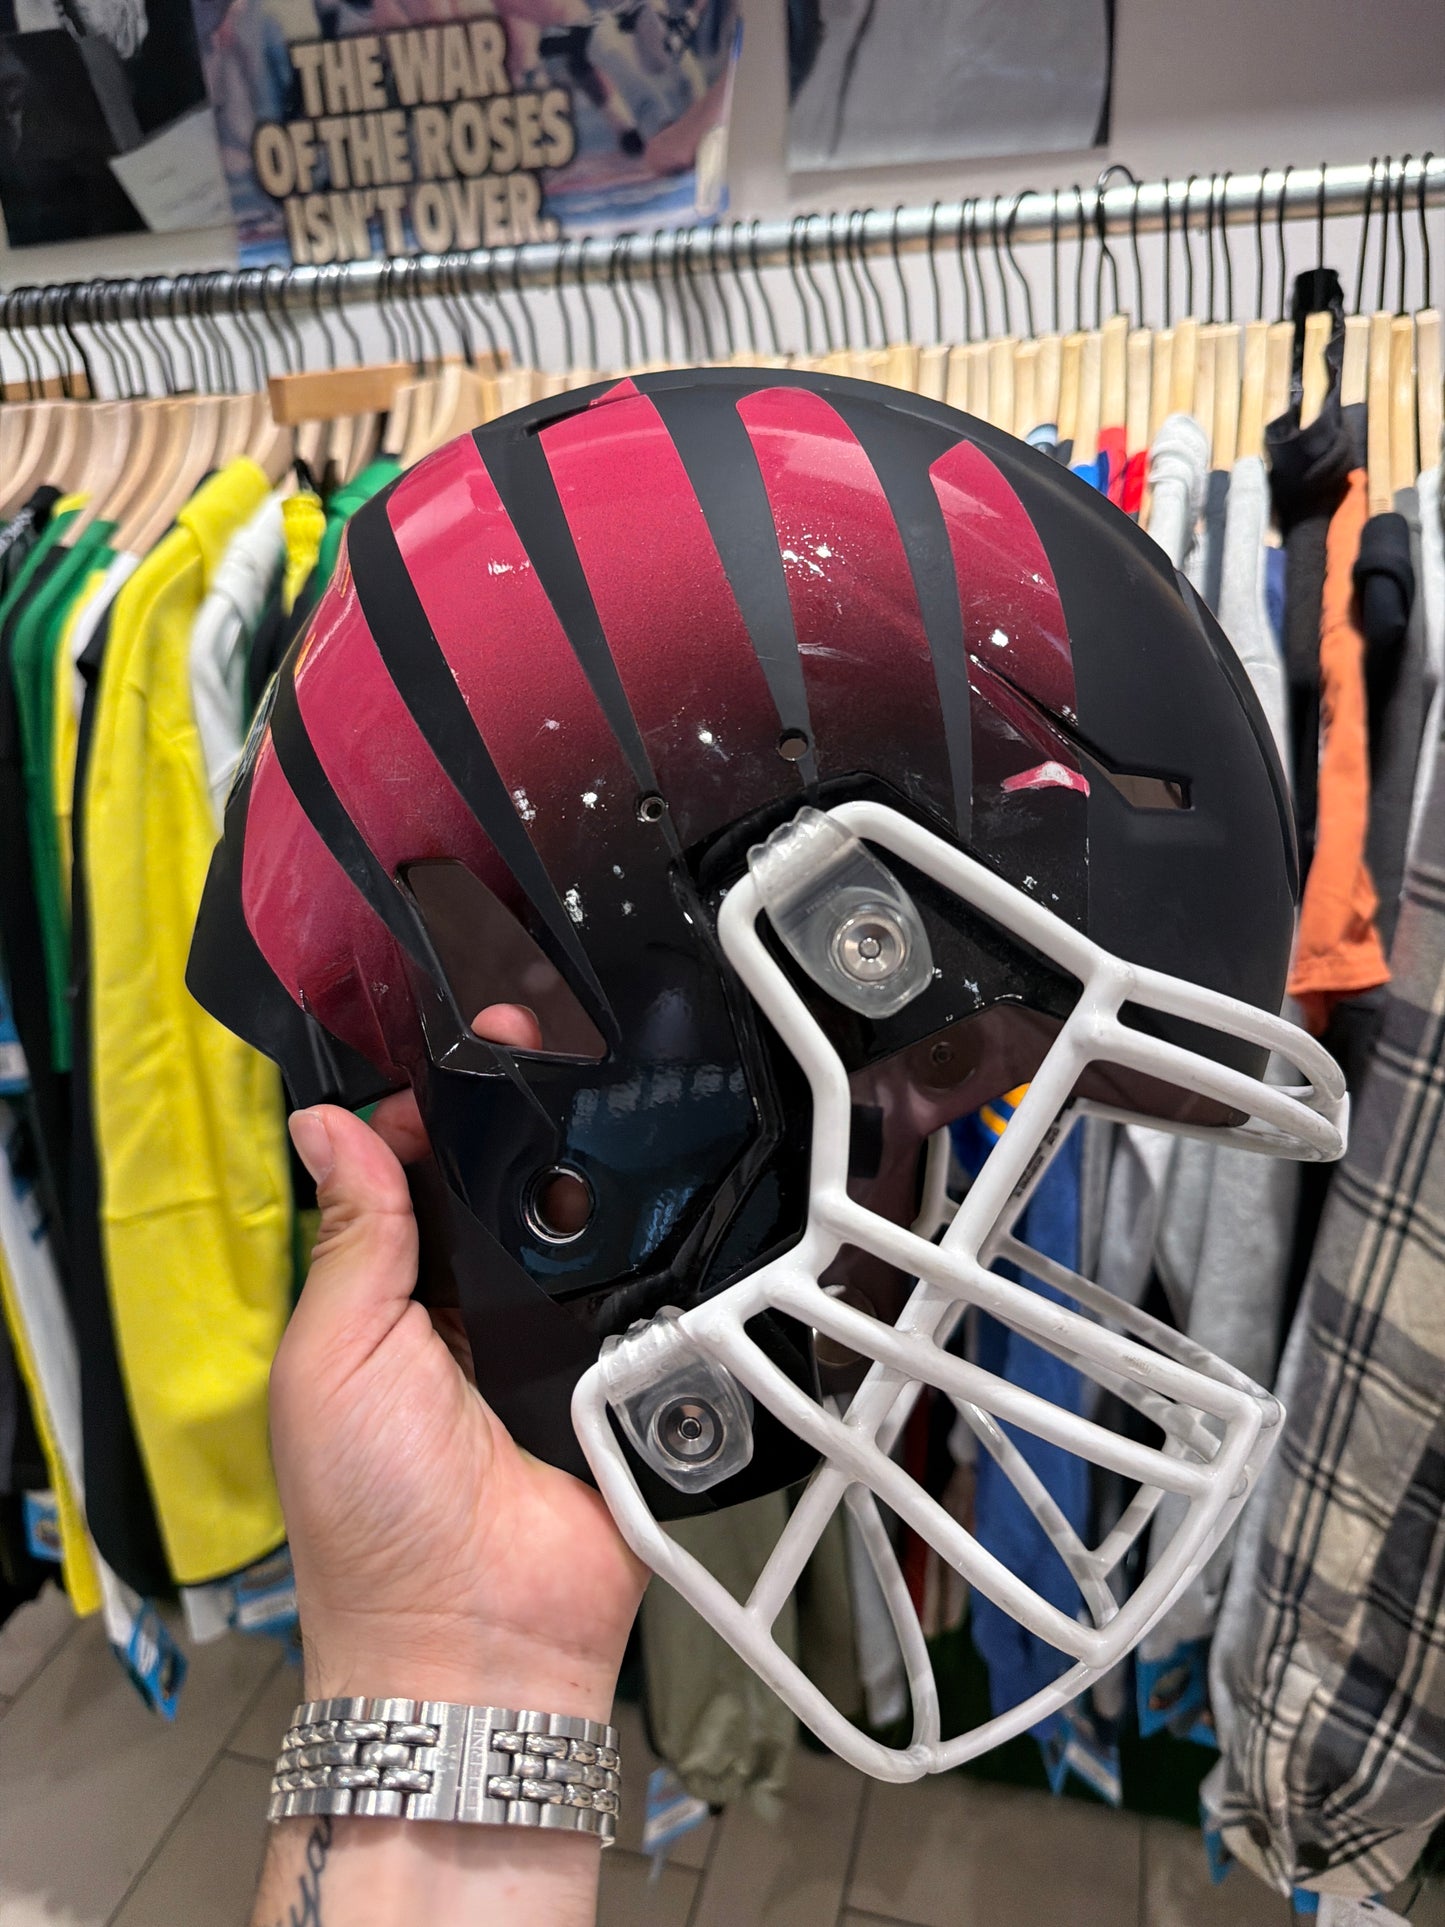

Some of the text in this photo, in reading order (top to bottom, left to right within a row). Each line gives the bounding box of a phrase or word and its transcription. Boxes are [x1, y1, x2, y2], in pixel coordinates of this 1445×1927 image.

[290, 21, 511, 117] THE WAR
[256, 91, 574, 197] OF THE ROSES
[285, 173, 559, 263] ISN'T OVER.
